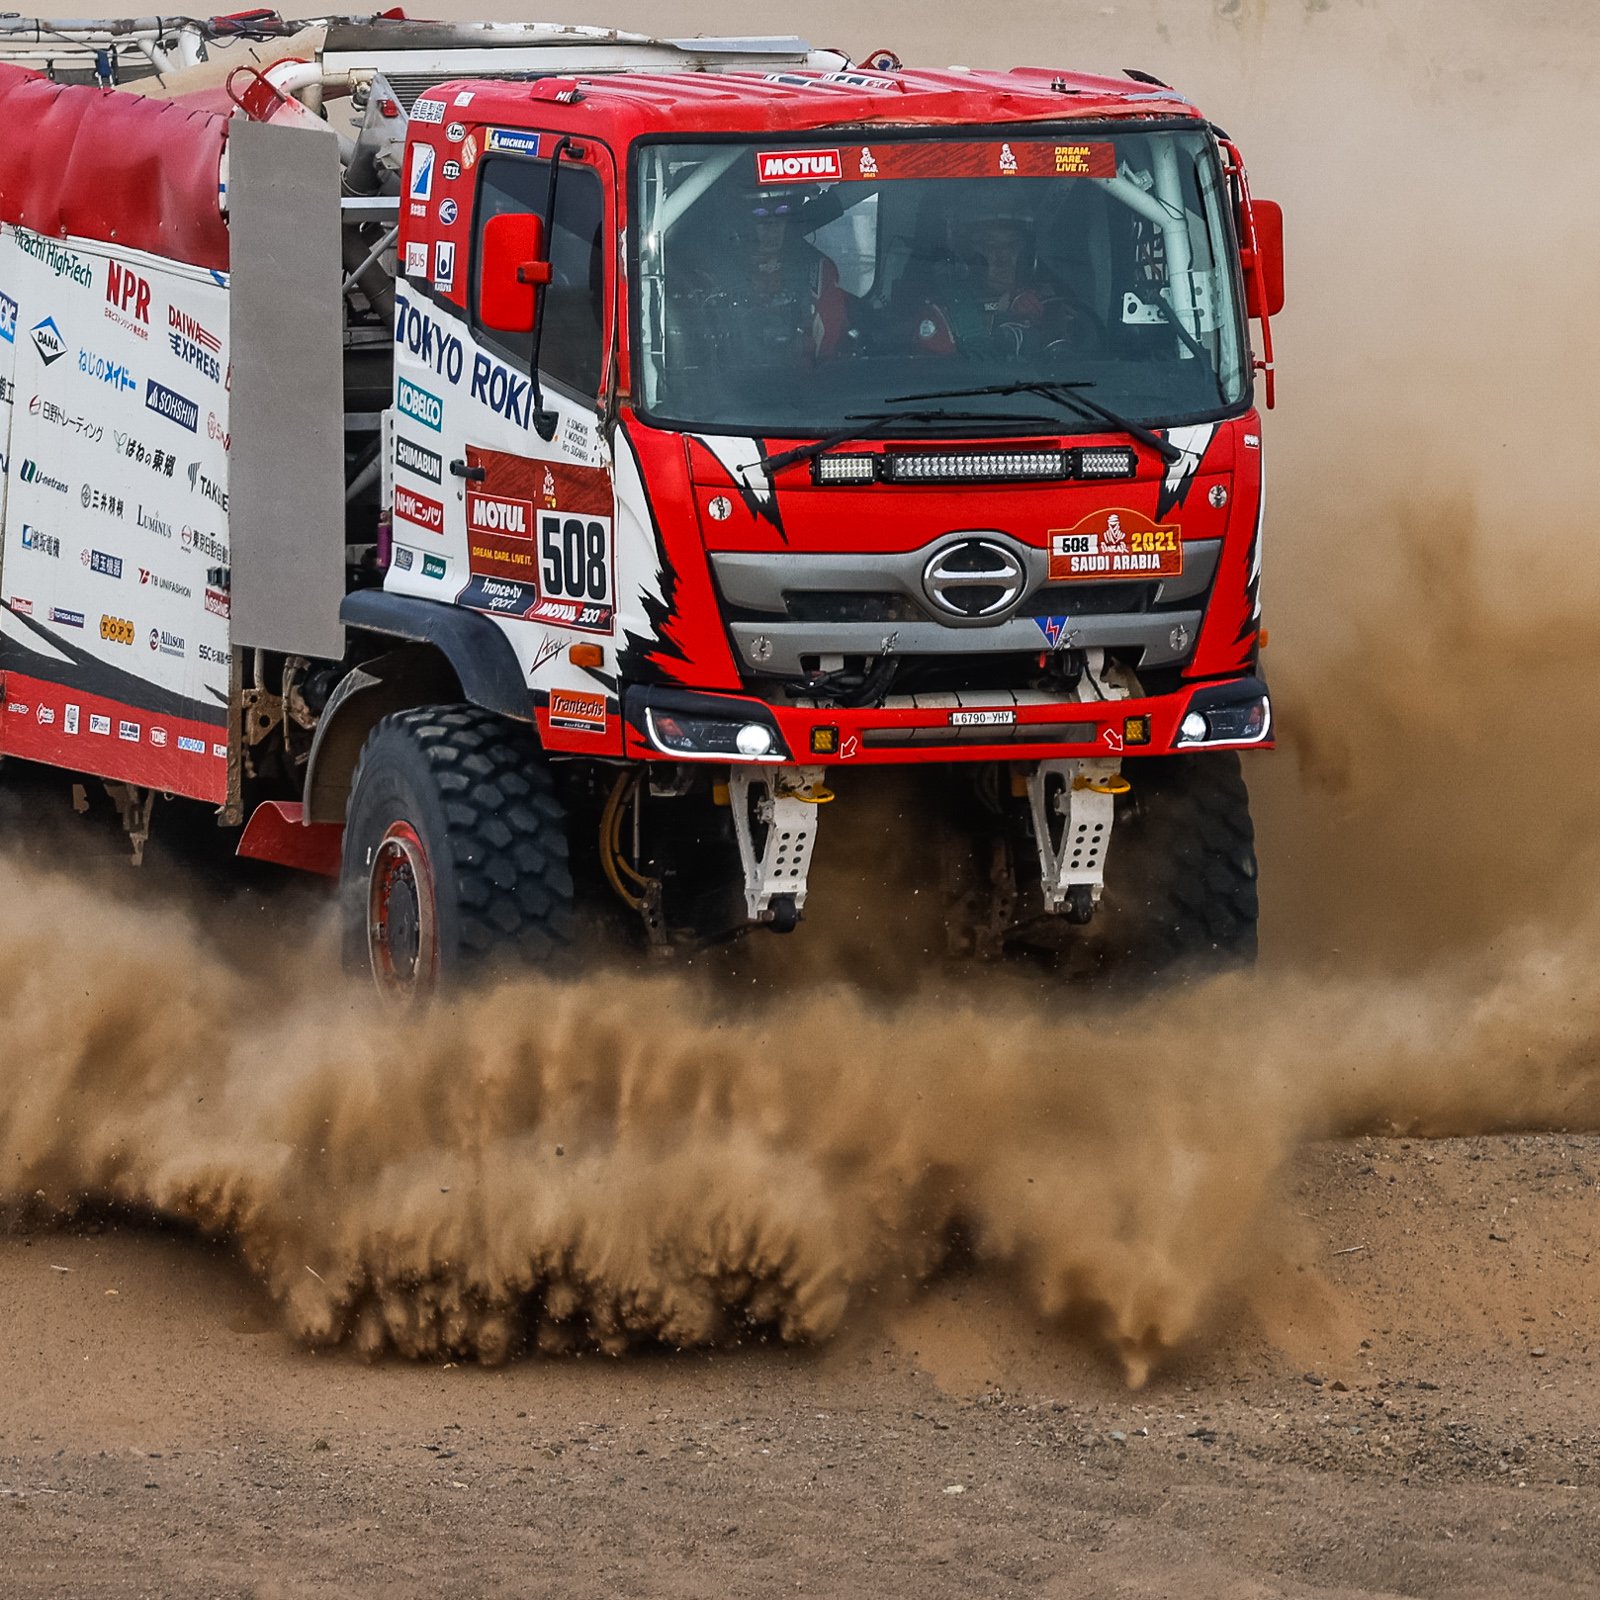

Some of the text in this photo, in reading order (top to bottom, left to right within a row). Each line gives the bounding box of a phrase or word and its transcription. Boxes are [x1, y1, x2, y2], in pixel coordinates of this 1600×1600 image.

[500, 137, 535, 149] MICHELIN
[1055, 147, 1090, 155] DREAM.
[764, 156, 837, 176] MOTUL
[1055, 155, 1083, 163] DARE.
[1056, 164, 1077, 172] LIVE
[106, 259, 151, 325] NPR
[169, 304, 203, 345] DAIWA
[38, 330, 59, 351] DANA
[169, 332, 220, 384] EXPRESS
[396, 294, 535, 431] TOKYO ROKI
[79, 347, 136, 392] ねじのメイドー
[159, 391, 197, 428] SOHSHIN
[399, 381, 441, 427] KOBELCO
[43, 400, 104, 443] 日野トレーディング
[398, 441, 440, 480] SHIMABUN
[35, 469, 69, 493] U-netrans
[396, 488, 442, 527] NHKニッパツ
[473, 498, 526, 533] MOTUL
[1062, 536, 1089, 553] 508
[1132, 532, 1177, 552] 2021
[472, 546, 493, 559] DREAM.
[494, 549, 511, 562] DARE.
[542, 516, 607, 601] 508
[1071, 553, 1161, 572] SAUDI ARABIA
[151, 574, 158, 587] TB
[159, 577, 192, 599] UNIFASHION
[489, 596, 517, 611] sport
[535, 602, 577, 622] MOTUL
[102, 622, 133, 638] TOPY
[160, 631, 185, 650] Allison
[961, 713, 986, 724] 6790
